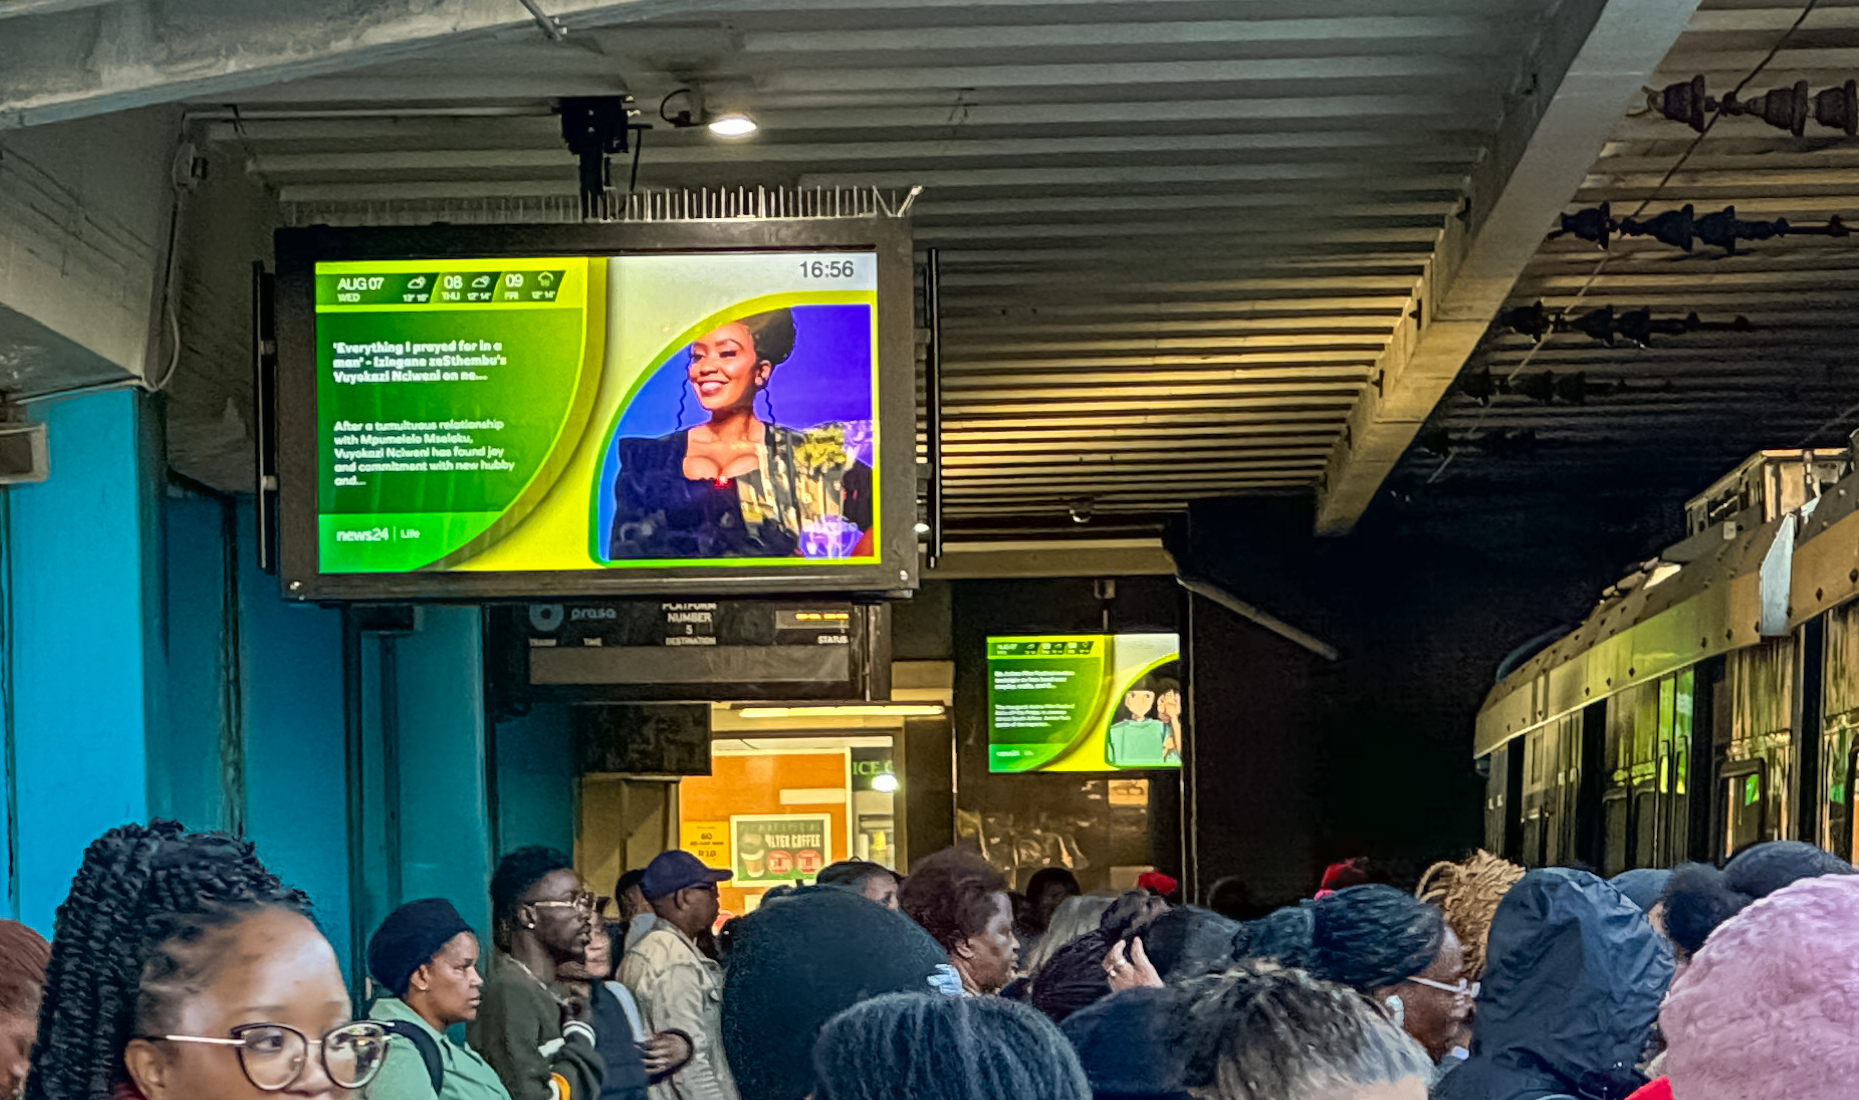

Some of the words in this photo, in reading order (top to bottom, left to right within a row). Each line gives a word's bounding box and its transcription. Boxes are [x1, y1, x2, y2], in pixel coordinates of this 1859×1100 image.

[799, 260, 854, 278] 16:56
[337, 277, 367, 290] AUG
[368, 277, 384, 290] 07
[444, 275, 463, 289] 08
[505, 273, 523, 287] 09
[337, 293, 360, 302] WED
[442, 292, 460, 300] THU
[333, 341, 403, 356] 'Everything
[405, 341, 411, 352] I
[412, 339, 456, 355] prayed
[458, 339, 477, 352] for
[479, 339, 491, 351] in
[493, 342, 502, 351] a
[332, 356, 364, 368] man'
[333, 370, 390, 385] Vuyokazi
[442, 371, 459, 381] on
[333, 420, 363, 431] After
[365, 423, 373, 431] a
[374, 420, 437, 431] tumultuous
[439, 419, 505, 431] relationship
[334, 434, 359, 445] with
[360, 433, 422, 447] Mpumelelo
[334, 447, 384, 461] Vuyokazi
[431, 447, 452, 457] has
[453, 446, 486, 457] found
[487, 445, 504, 459] joy
[334, 461, 356, 472] and
[358, 461, 428, 472] commitment
[429, 460, 454, 471] with
[455, 462, 479, 470] new
[480, 459, 515, 472] hubby
[336, 526, 389, 541] news24
[400, 528, 420, 538] Life
[571, 608, 617, 620] prasa
[667, 612, 713, 623] NUMBER
[665, 636, 717, 646] DESTINATION
[852, 760, 880, 775] ICE
